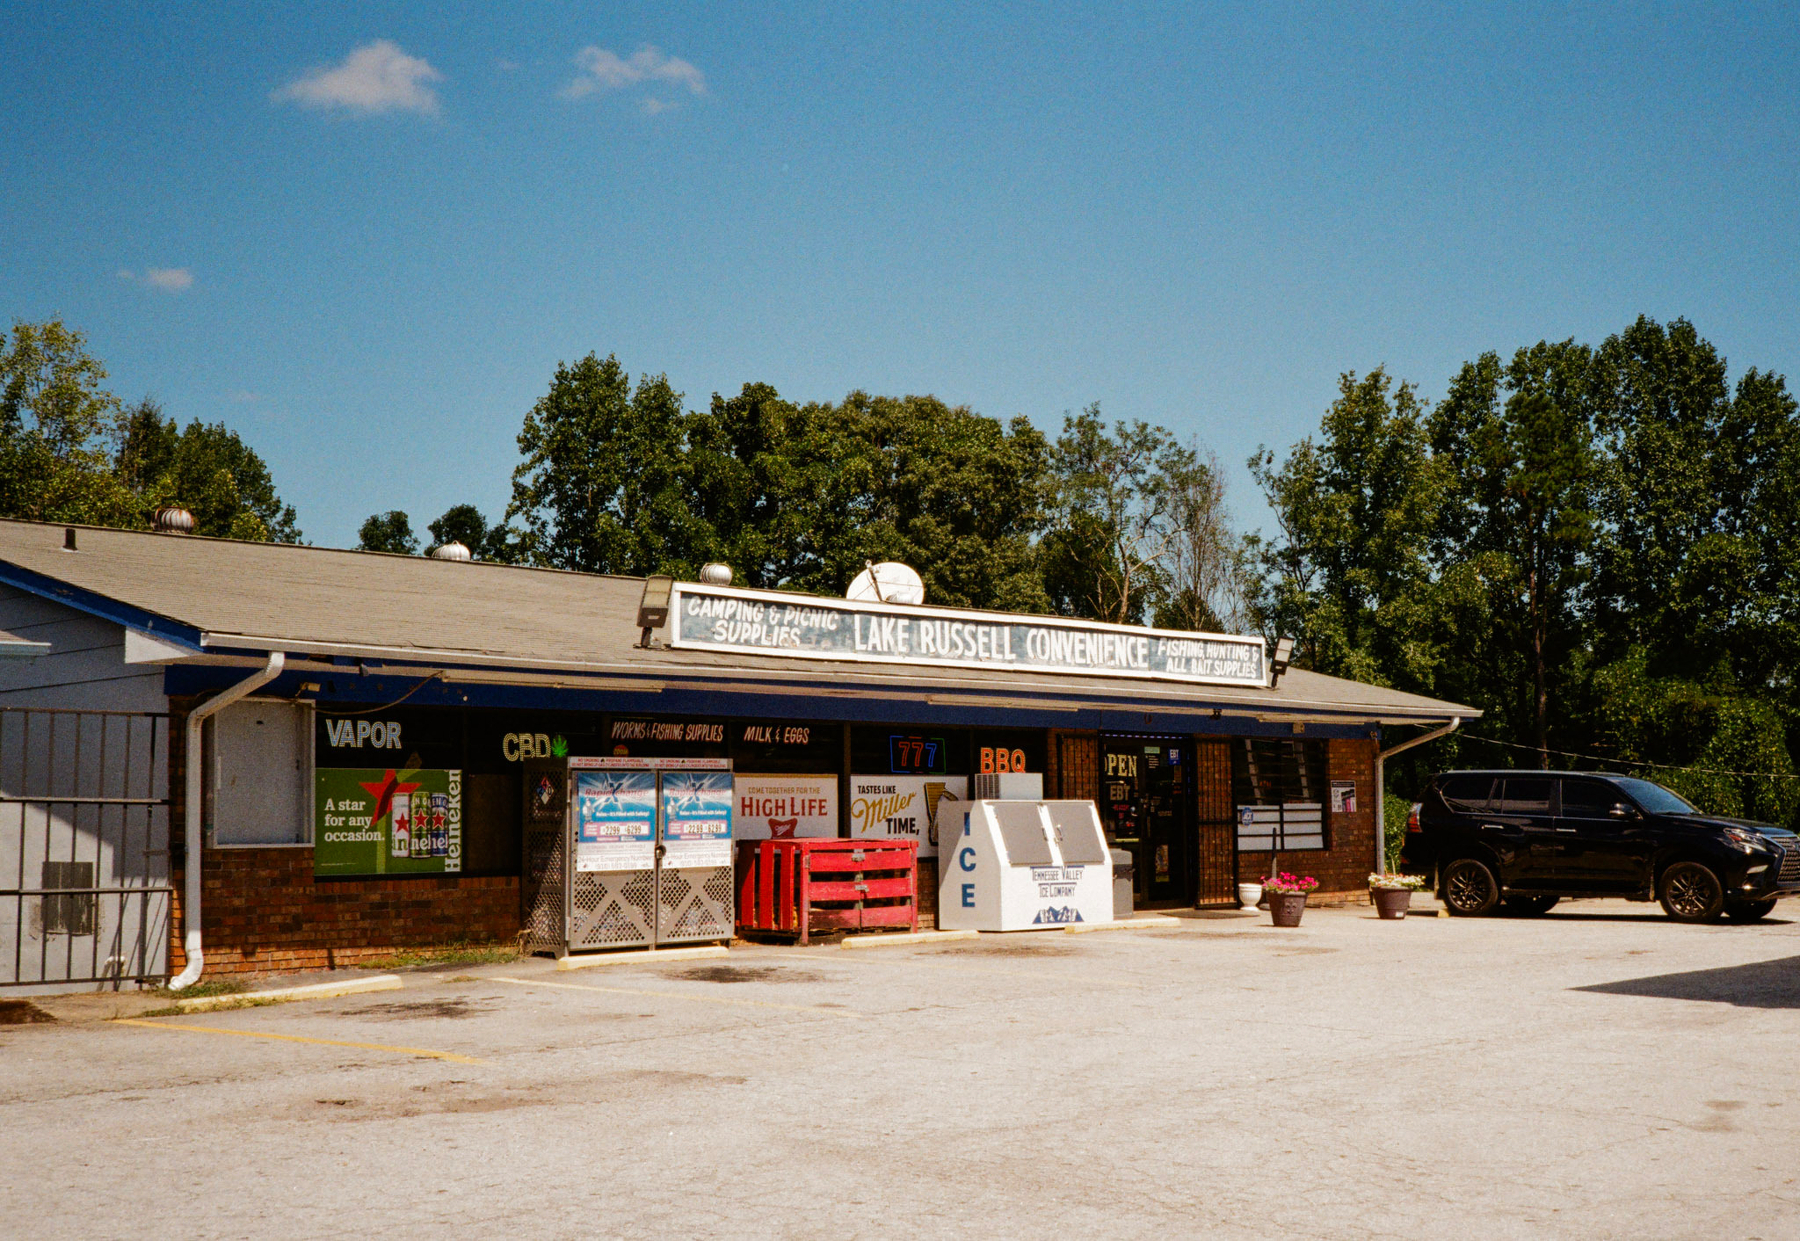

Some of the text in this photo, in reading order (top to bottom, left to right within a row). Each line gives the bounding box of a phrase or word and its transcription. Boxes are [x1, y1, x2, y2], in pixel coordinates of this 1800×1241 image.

[688, 596, 839, 631] CAMPING & PICNIC
[714, 620, 800, 648] SUPPLIES
[854, 614, 1149, 668] LAKE RUSSELL CONVENIENCE
[1206, 641, 1250, 661] HUNTING
[1252, 645, 1260, 662] &
[1166, 657, 1257, 679] ALL BAIT SUPPLIES
[325, 718, 402, 749] VAPOR
[611, 721, 646, 739] WORMS
[651, 722, 685, 740] FISHING
[685, 723, 724, 742] SUPPLIES
[743, 726, 773, 743] MILK
[783, 727, 811, 745] EGGS
[502, 732, 552, 762] CBD
[898, 741, 938, 768] 777
[1169, 748, 1180, 760] EBT
[980, 747, 1026, 774] BBQ
[1104, 753, 1138, 778] PEN
[748, 786, 821, 795] COME TOGETHER FOR THE
[857, 785, 897, 794] TASTES LIKE
[1110, 783, 1131, 801] EBT
[324, 798, 366, 811] A star
[741, 796, 828, 817] HIGH LIFE
[851, 790, 917, 833] Miller
[324, 813, 373, 830] for any
[444, 769, 462, 873] Heineken
[885, 817, 920, 836] TIME,
[324, 829, 385, 842] occasion.
[1061, 865, 1085, 880] VALLEY
